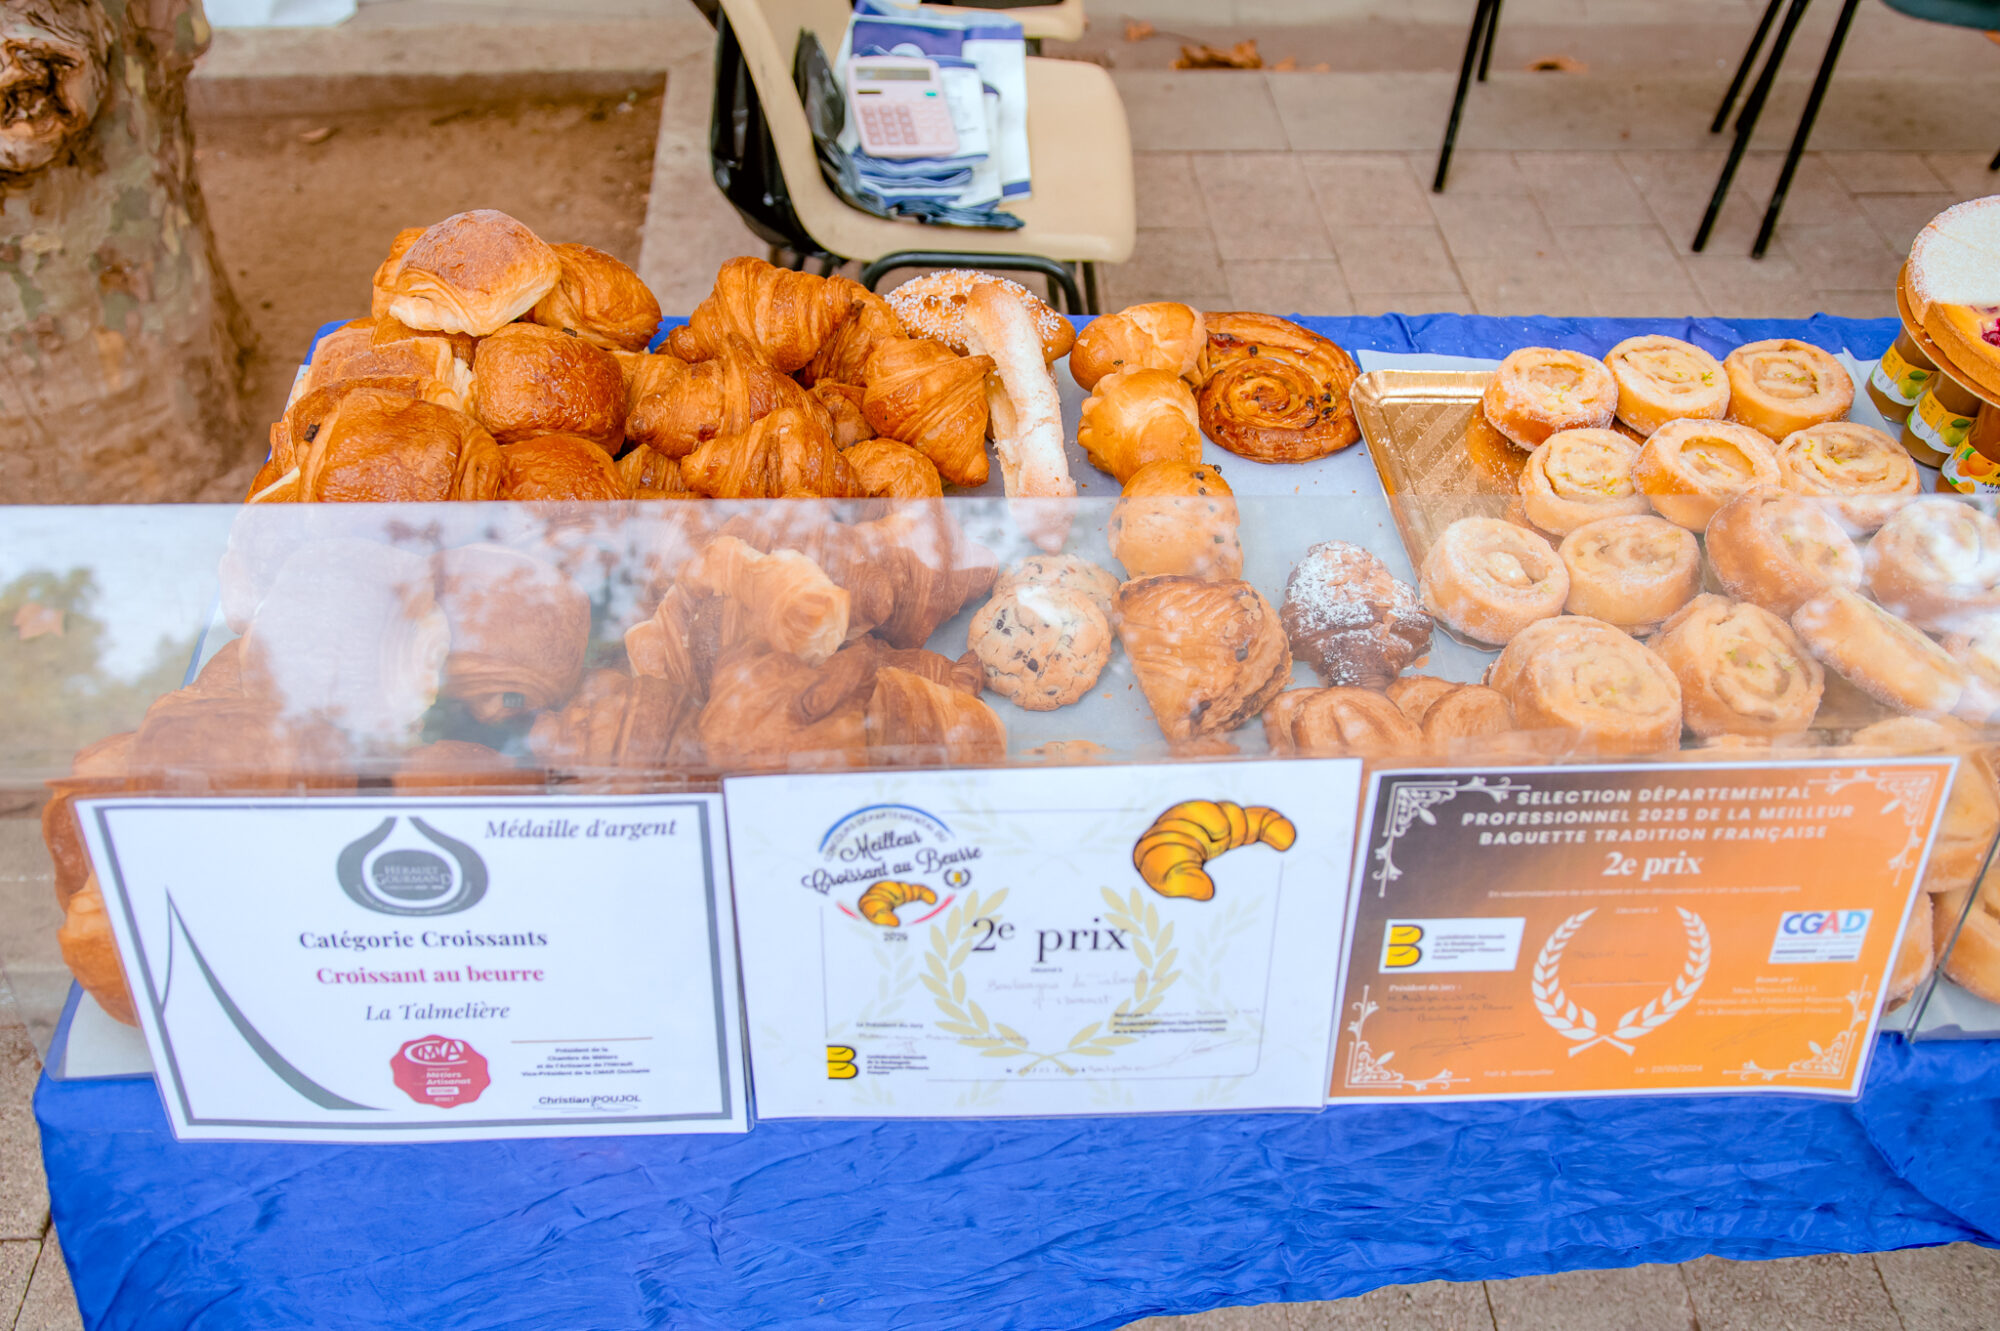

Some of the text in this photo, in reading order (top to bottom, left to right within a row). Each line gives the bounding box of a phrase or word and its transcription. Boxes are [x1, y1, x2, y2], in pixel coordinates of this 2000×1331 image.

[1516, 785, 1811, 806] SELECTION DÉPARTEMENTAL
[1461, 804, 1855, 827] PROFESSIONNEL 2025 DE LA MEILLEUR
[484, 817, 678, 841] Médaille d'argent
[1478, 825, 1828, 846] BAGUETTE TRADITION FRANÇAISE
[839, 829, 923, 862] Meilleur
[800, 846, 983, 895] Croissant au Beurre
[1601, 850, 1704, 881] 2e prix
[1783, 911, 1868, 935] CGAD
[298, 929, 548, 951] Catégorie Croissants
[970, 917, 1130, 963] 2e prix
[316, 965, 545, 984] Croissant au beurre
[365, 1001, 511, 1020] La Talmelière
[538, 1094, 590, 1105] Christian
